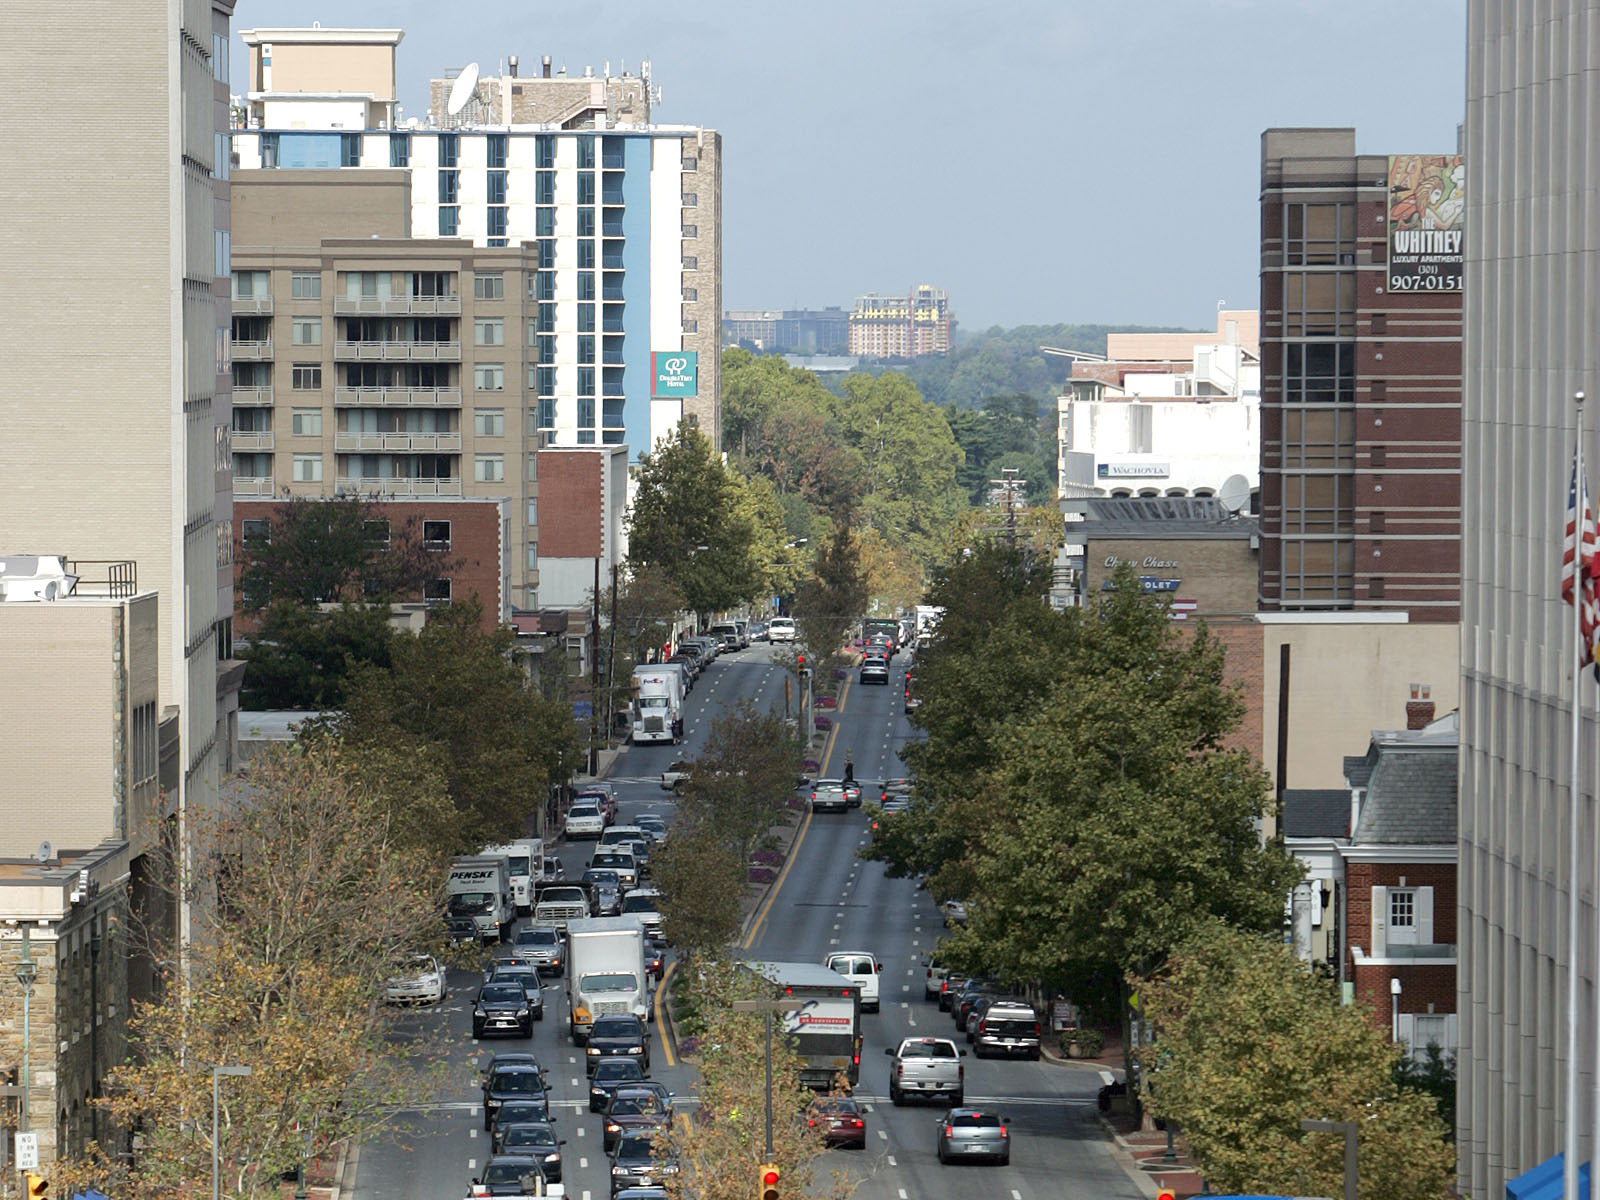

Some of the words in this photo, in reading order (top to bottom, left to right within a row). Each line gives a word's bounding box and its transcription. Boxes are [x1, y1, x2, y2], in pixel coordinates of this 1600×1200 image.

[1394, 230, 1462, 253] WHITNEY
[1392, 255, 1420, 263] LUXURY
[1420, 255, 1464, 263] APARTMENTS
[1417, 264, 1439, 274] (301)
[1391, 275, 1464, 290] 907-0151
[1112, 466, 1165, 475] WACHOVIA
[1142, 555, 1179, 568] Chase
[451, 871, 495, 880] PENSKE
